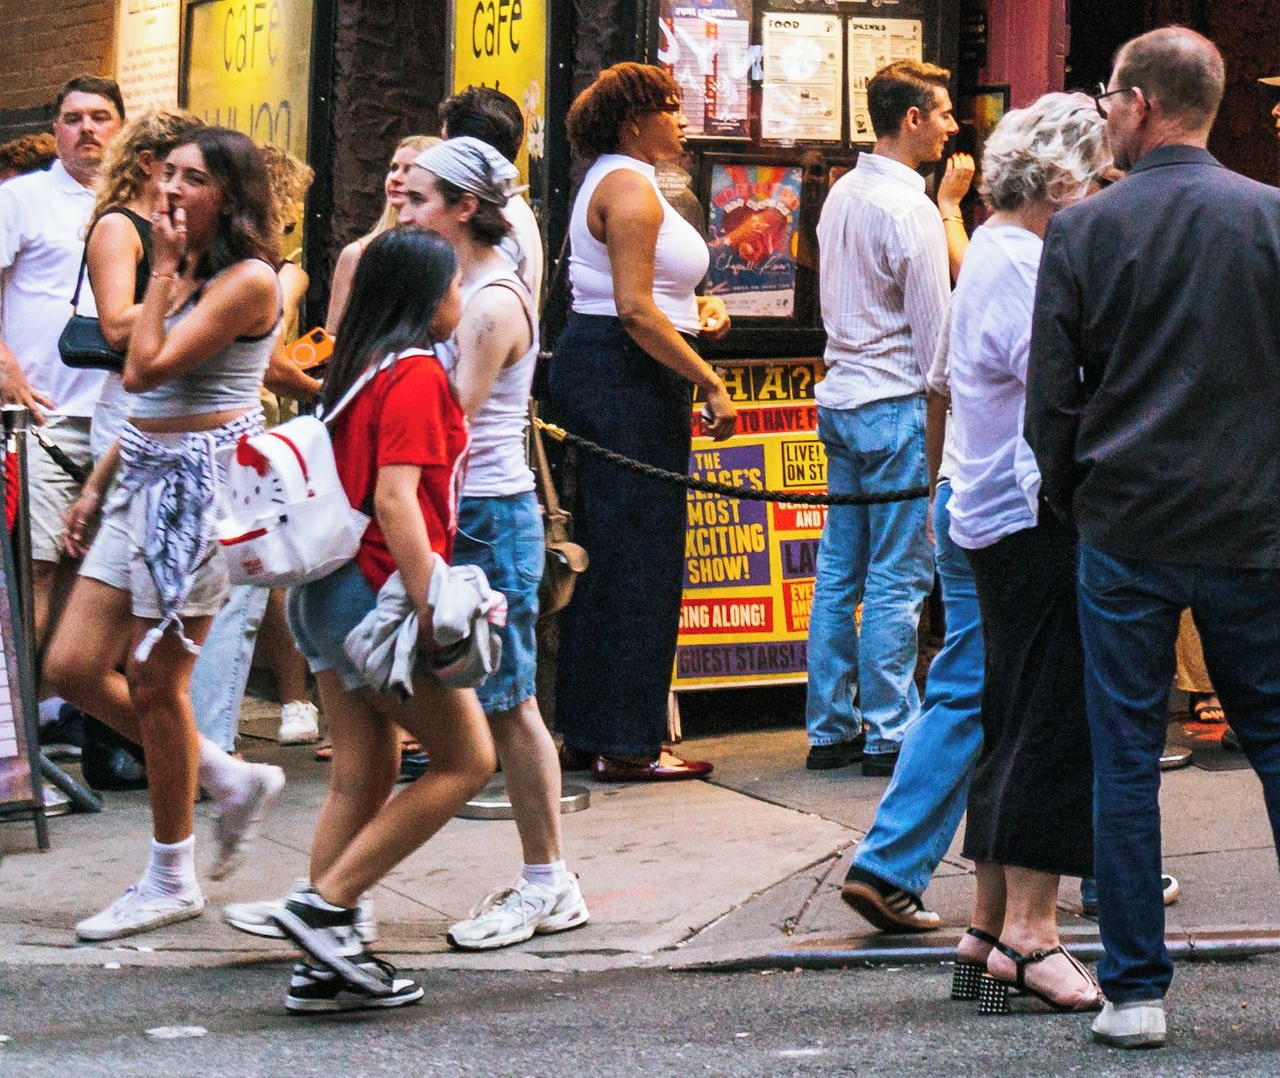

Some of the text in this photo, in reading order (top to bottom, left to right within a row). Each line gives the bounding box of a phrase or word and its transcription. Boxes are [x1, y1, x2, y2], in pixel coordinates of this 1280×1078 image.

[768, 20, 800, 29] FOOD
[718, 365, 812, 401] HA?
[740, 410, 759, 432] TO
[762, 408, 804, 431] HAVE
[695, 452, 722, 470] THE
[786, 444, 820, 463] LIVE!
[787, 463, 806, 482] ON
[687, 498, 740, 526] MOST
[796, 510, 821, 527] AND
[685, 523, 766, 558] XCITING
[688, 554, 751, 584] SHOW!
[712, 603, 766, 628] ALONG!
[680, 644, 796, 674] GUEST STARS!
